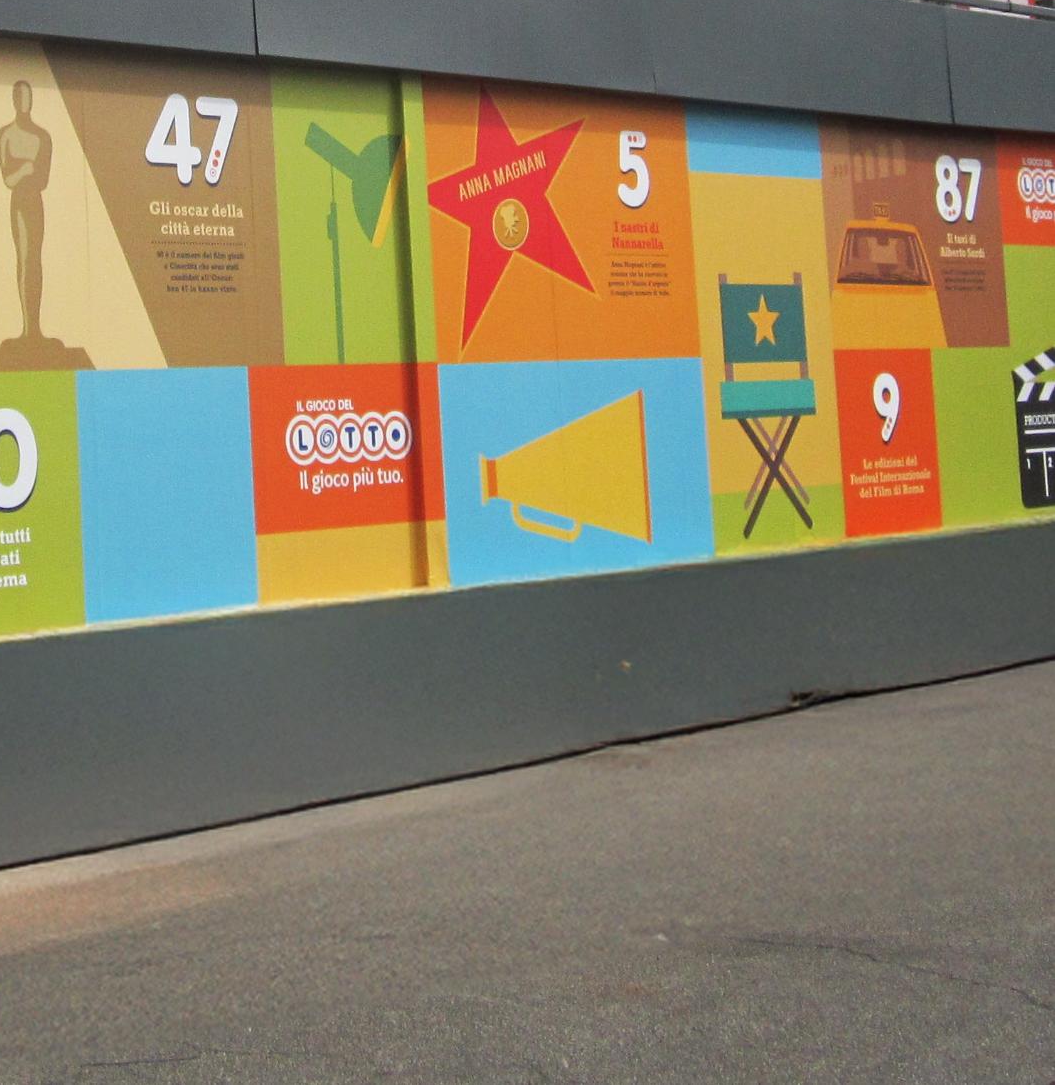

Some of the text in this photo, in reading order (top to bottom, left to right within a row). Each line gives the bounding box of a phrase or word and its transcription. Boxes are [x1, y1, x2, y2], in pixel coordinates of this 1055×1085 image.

[145, 93, 239, 185] 47
[459, 150, 546, 202] ANNA MAGNANI
[617, 130, 650, 208] 5
[935, 154, 982, 223] 87
[149, 201, 244, 219] Gli oscar della
[161, 221, 235, 237] città eterna
[649, 221, 659, 234] di
[296, 399, 354, 412] IL GIOCO DEL
[873, 372, 900, 443] 9
[289, 415, 408, 461] LOTTO
[863, 458, 873, 470] Le
[906, 455, 918, 467] del
[1027, 458, 1031, 469] 1
[299, 467, 404, 494] Il gioco più tuo.
[859, 487, 872, 499] del
[873, 486, 892, 497] Film
[893, 485, 901, 495] di
[0, 527, 31, 544] tutti
